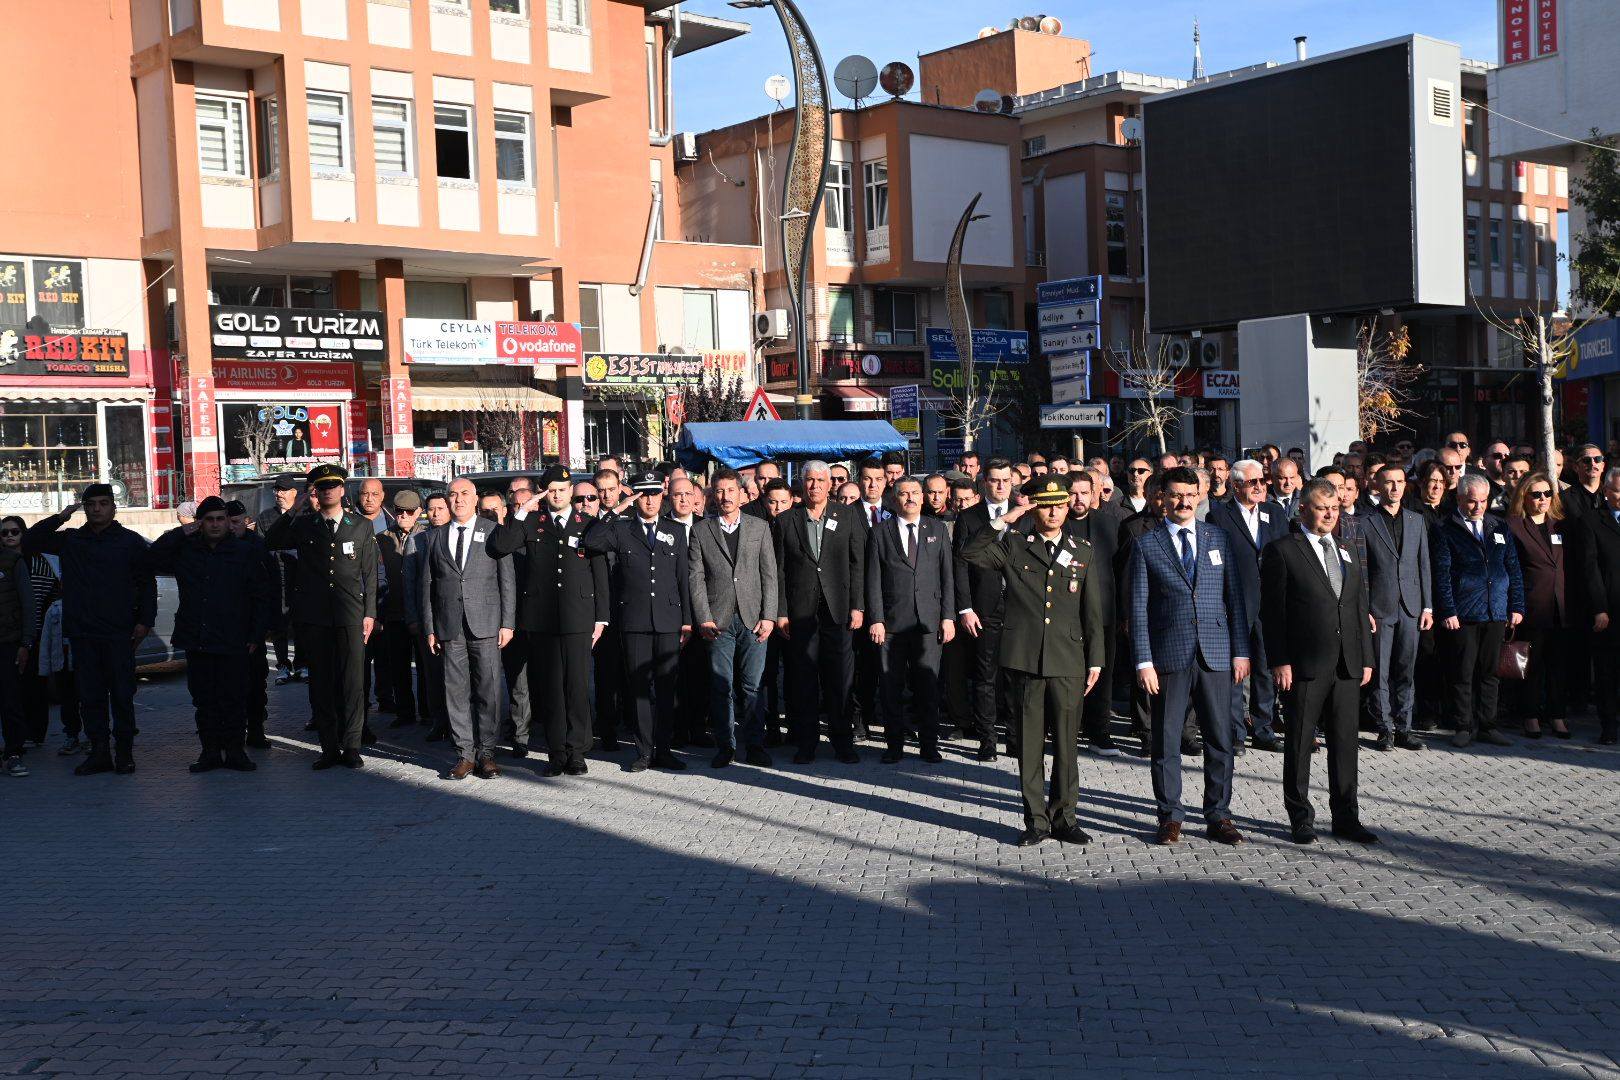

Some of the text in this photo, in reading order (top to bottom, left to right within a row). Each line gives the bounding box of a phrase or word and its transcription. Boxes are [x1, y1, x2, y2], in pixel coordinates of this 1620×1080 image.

[38, 291, 58, 303] RED
[217, 312, 379, 335] GOLD TURİZM
[1042, 313, 1064, 323] Adliye
[440, 322, 557, 335] CEYLAN TELEKOM
[410, 338, 477, 350] Türk Telekom
[519, 339, 576, 353] vodafone
[977, 335, 1008, 344] MOLA
[1043, 337, 1068, 348] Sanayi
[24, 335, 78, 360] RED
[245, 350, 296, 358] ZAFER
[1580, 337, 1613, 360] TURKCELL
[47, 363, 127, 373] TOBACCO SHISHA
[230, 367, 278, 380] AIRLINES
[197, 378, 211, 436] ZAFER
[396, 381, 408, 434] ZAFER
